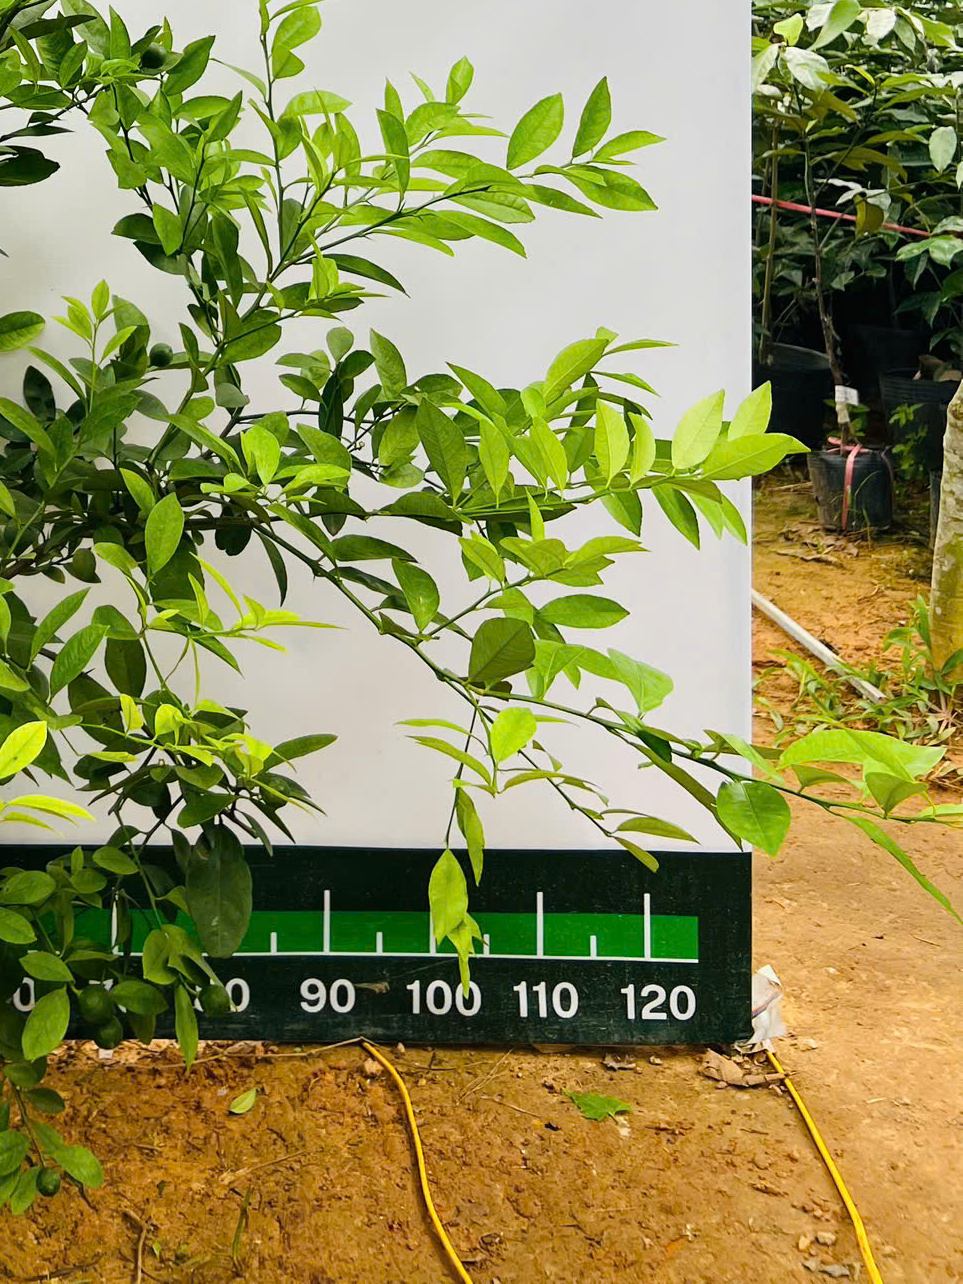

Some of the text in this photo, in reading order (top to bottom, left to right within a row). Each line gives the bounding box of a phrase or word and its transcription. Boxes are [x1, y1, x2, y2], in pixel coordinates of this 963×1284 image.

[194, 978, 251, 1013] 0
[300, 978, 356, 1013] 90
[405, 979, 482, 1017] 100
[512, 980, 579, 1019] 110
[620, 983, 696, 1021] 120
